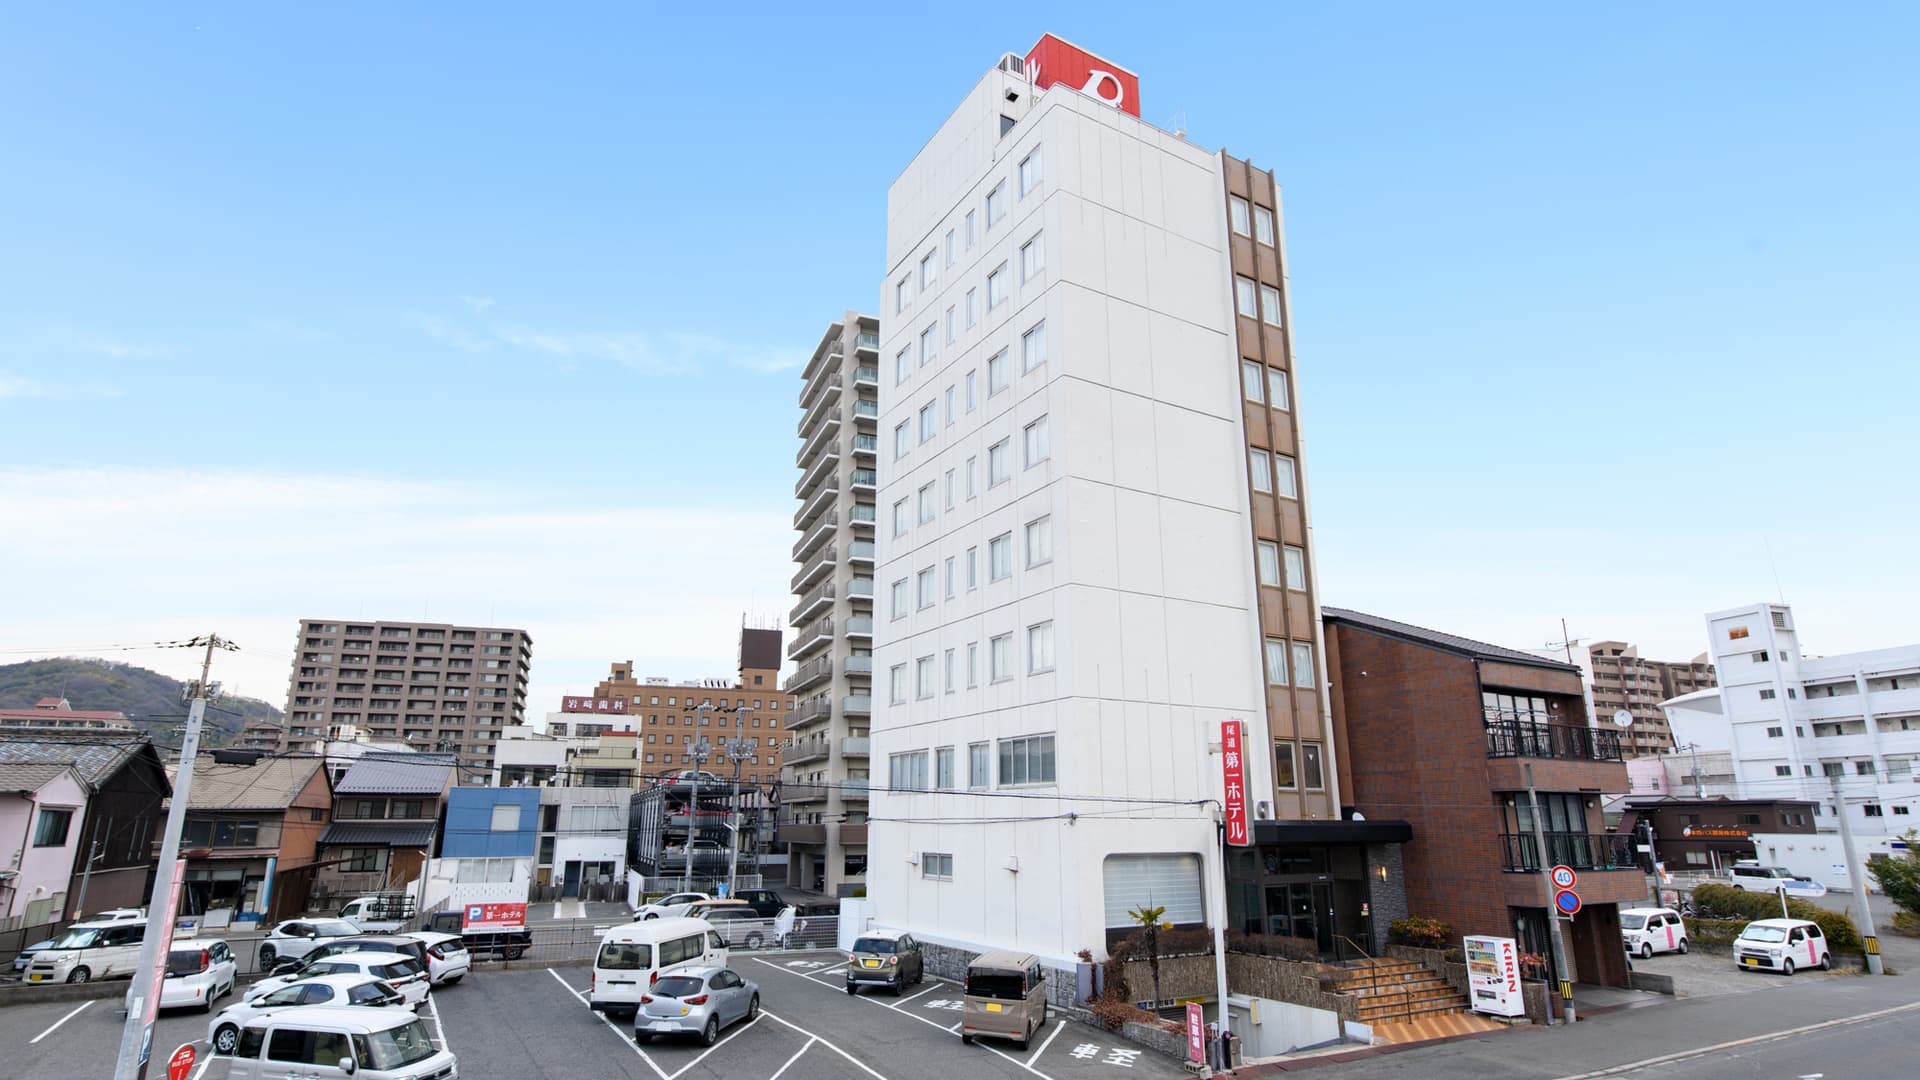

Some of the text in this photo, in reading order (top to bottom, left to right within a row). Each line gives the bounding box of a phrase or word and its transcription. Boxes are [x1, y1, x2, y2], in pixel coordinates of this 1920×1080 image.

[1226, 725, 1243, 840] 尾道 第一ホテル
[1557, 872, 1571, 883] 40
[469, 907, 482, 920] P
[486, 911, 523, 920] 第一ホテル
[1502, 943, 1517, 993] KIRIN
